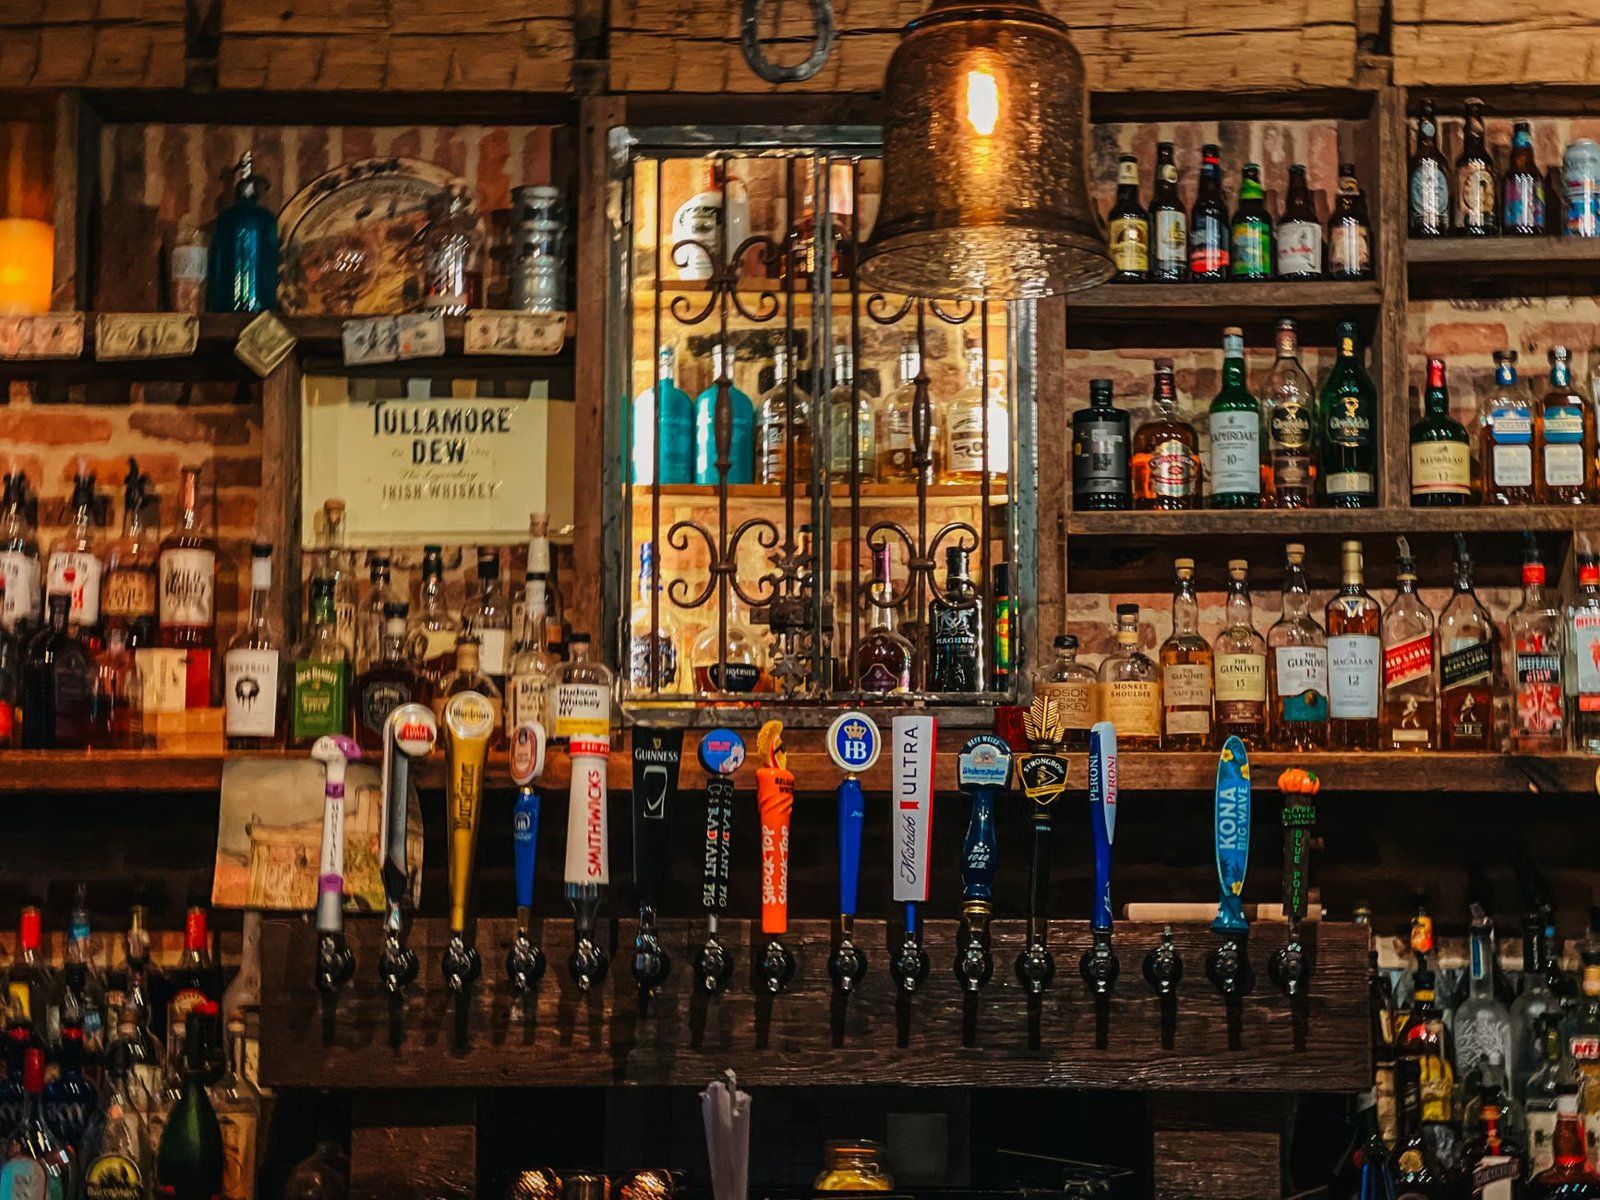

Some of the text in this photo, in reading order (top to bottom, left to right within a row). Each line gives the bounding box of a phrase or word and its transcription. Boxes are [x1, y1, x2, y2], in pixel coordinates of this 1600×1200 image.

[367, 401, 511, 436] TULLAMORE
[412, 439, 466, 465] DEW
[382, 483, 497, 500] IRISH WHISKEY
[936, 637, 974, 645] MAGNUS
[1333, 658, 1374, 666] MACALLAN
[1403, 647, 1431, 662] LABEL
[1444, 660, 1466, 673] BLACK
[1467, 654, 1489, 665] LABEL
[1220, 665, 1260, 673] GLENLIVET
[1305, 669, 1317, 679] 12
[1236, 679, 1245, 687] 15
[1348, 675, 1360, 686] 12
[559, 688, 598, 697] Hudson
[559, 699, 600, 708] Whiskey
[559, 707, 573, 716] NY
[635, 747, 679, 762] GUINNESS
[844, 740, 867, 760] HB
[1023, 757, 1065, 775] STRONGBOW
[1089, 753, 1100, 802] PERONI
[1106, 755, 1116, 805] PERONI
[901, 726, 919, 885] Michelob ULTRA
[1219, 786, 1237, 850] KONA
[1237, 786, 1248, 850] BIG WAVE
[719, 808, 732, 880] RADIANT
[703, 807, 720, 908] RADIANT PIG
[762, 825, 776, 906] SHOCK TOP
[1292, 829, 1303, 913] BLUE POINT
